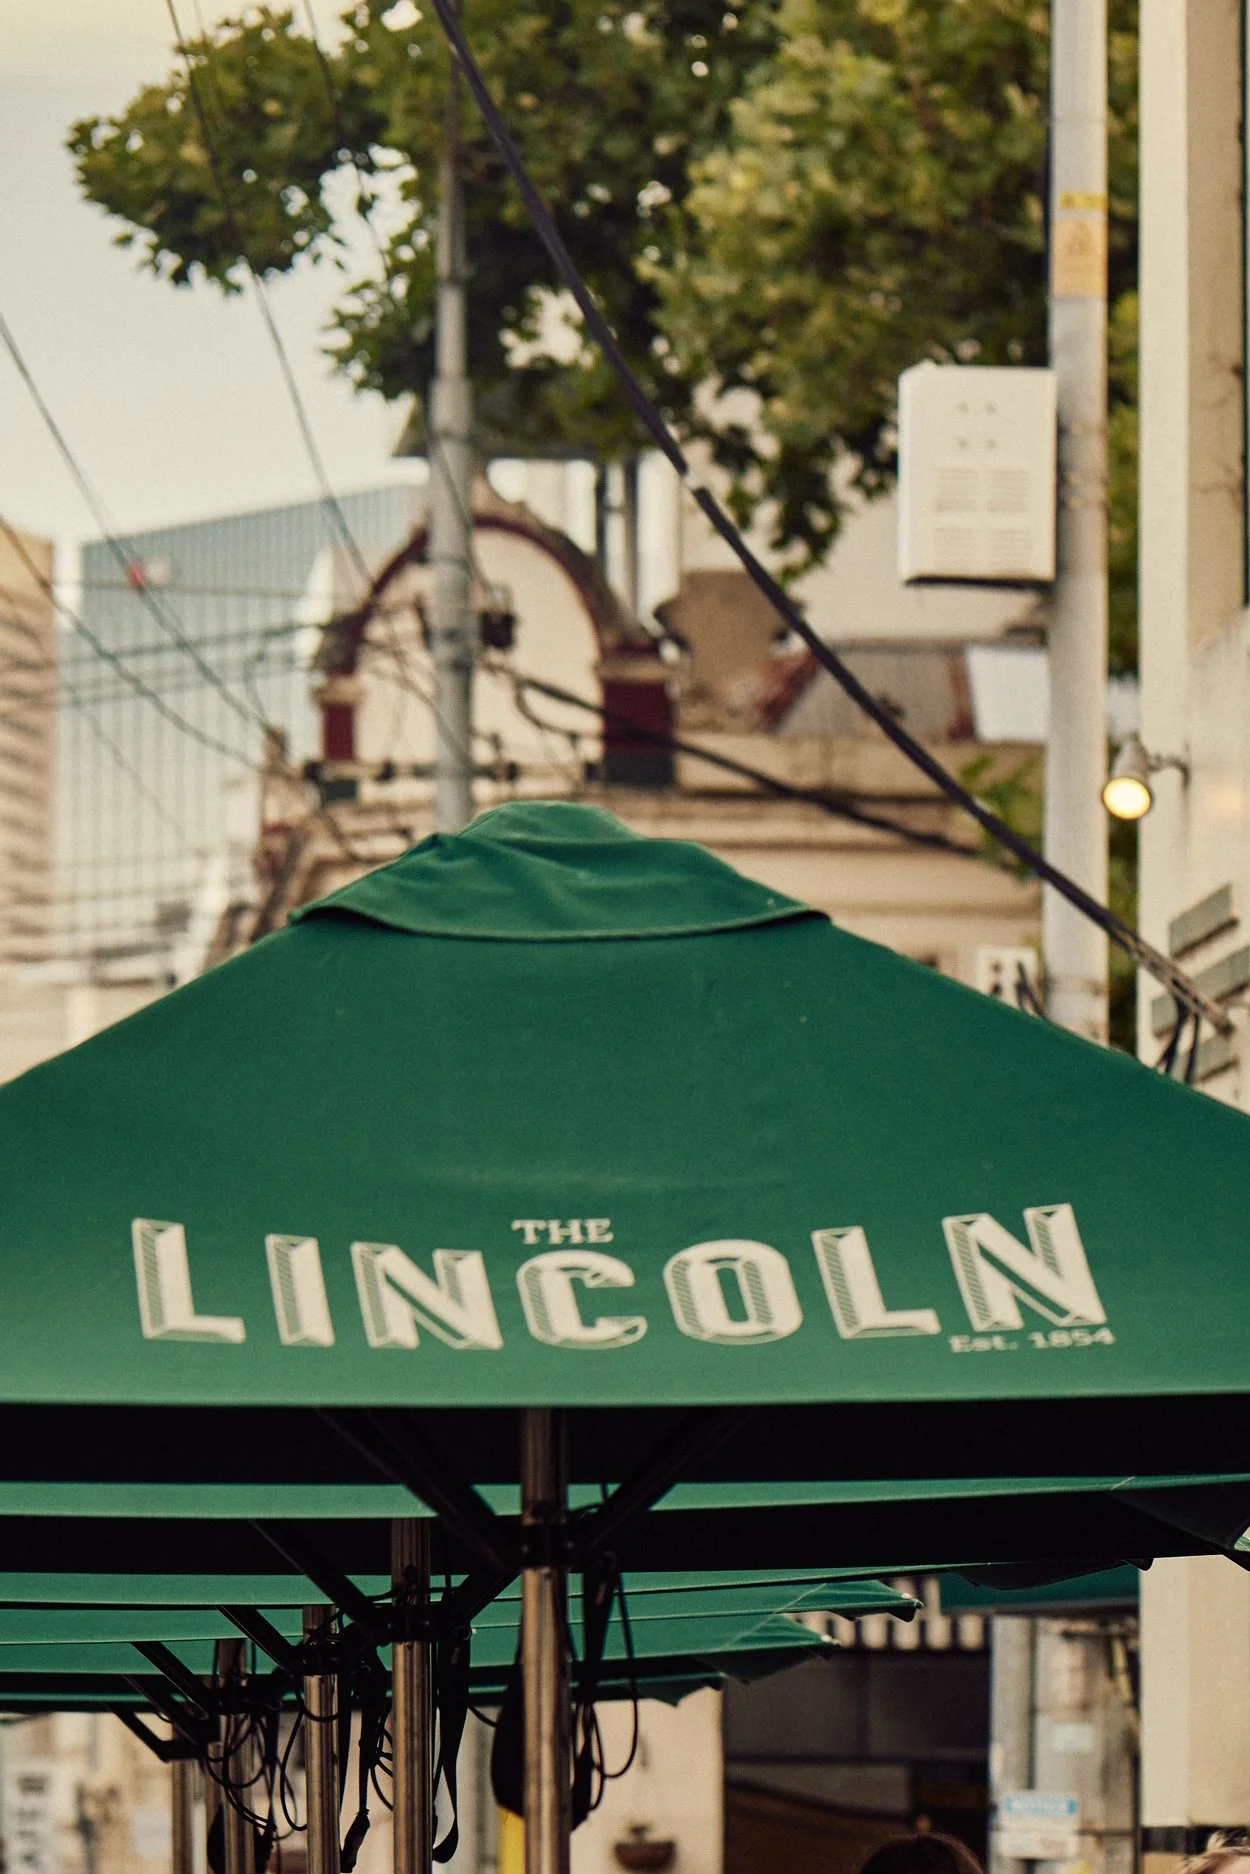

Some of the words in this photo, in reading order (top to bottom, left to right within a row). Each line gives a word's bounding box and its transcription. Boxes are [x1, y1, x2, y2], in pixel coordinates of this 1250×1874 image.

[511, 1217, 614, 1245] THE
[131, 1202, 1108, 1350] LINCOLN
[1029, 1327, 1115, 1348] 1854
